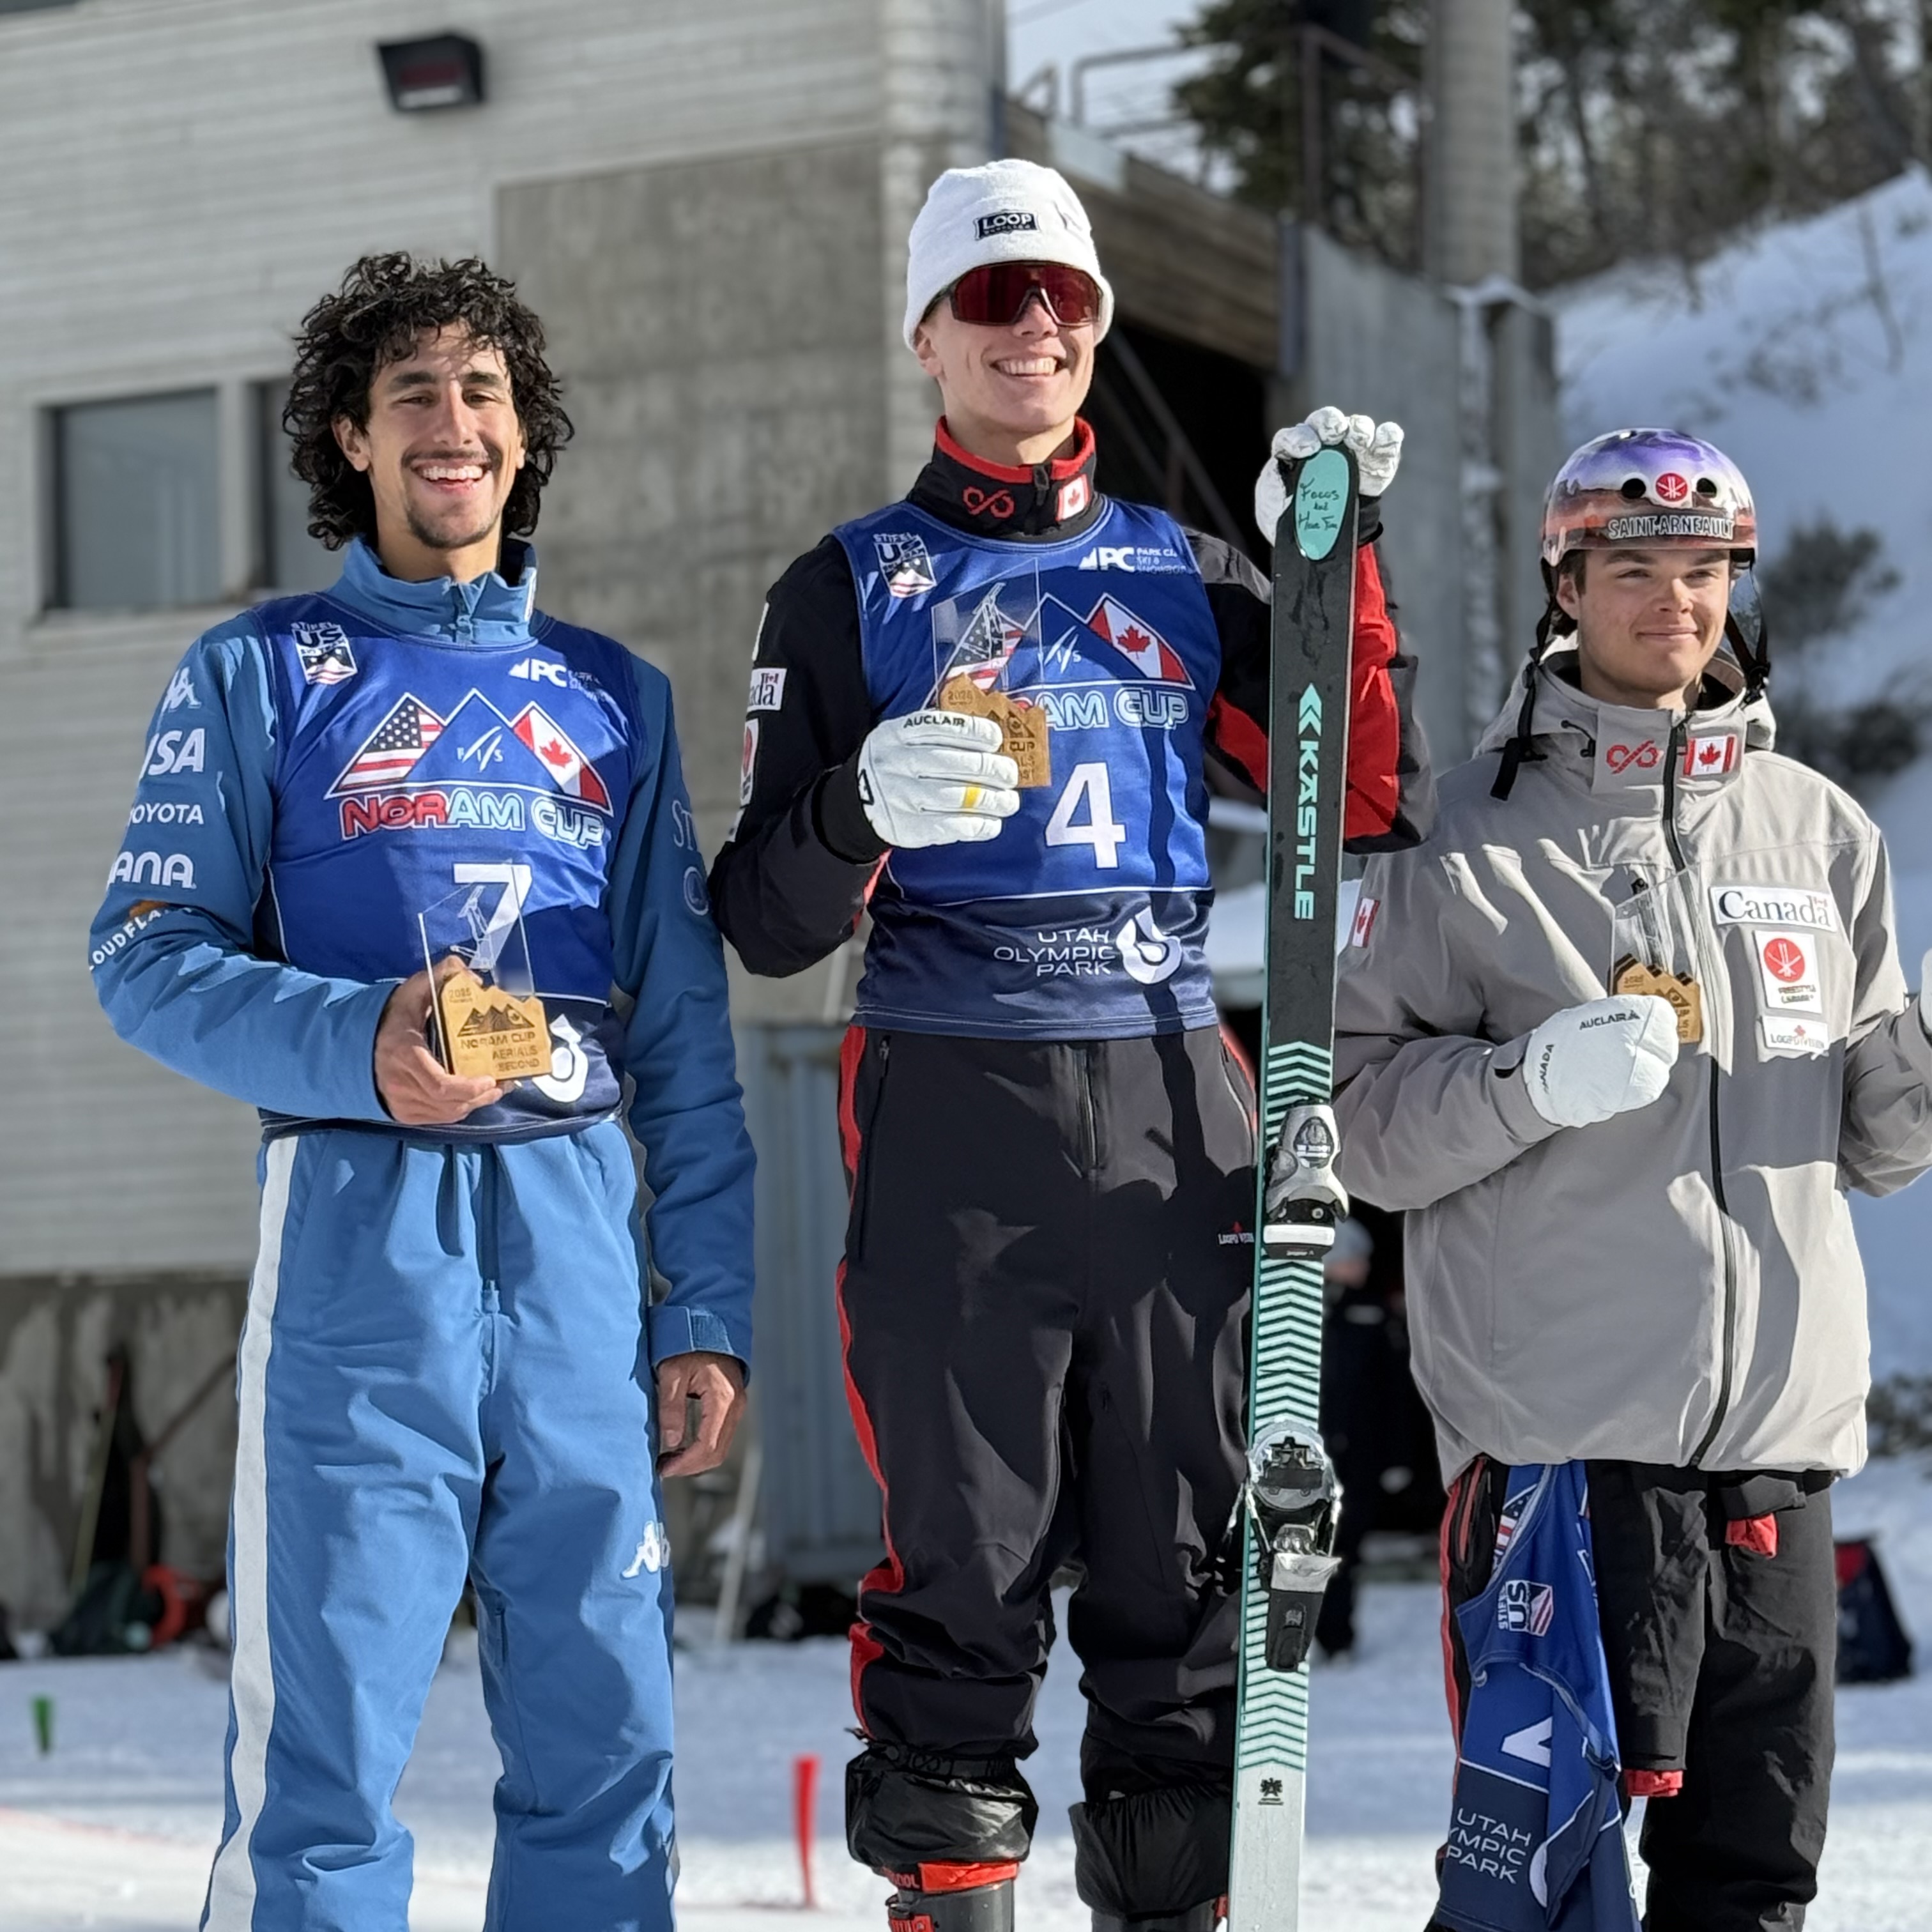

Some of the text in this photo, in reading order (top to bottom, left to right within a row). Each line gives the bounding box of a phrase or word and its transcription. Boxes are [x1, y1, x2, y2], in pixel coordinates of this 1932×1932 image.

[983, 213, 1032, 229] LOOP
[295, 627, 343, 648] US
[1113, 687, 1189, 730] CUP
[903, 715, 966, 729] AUCLAIR
[127, 803, 204, 827] OYOTA
[341, 788, 605, 850] NORAM CUP
[1045, 762, 1126, 868] 4
[106, 852, 194, 890] ANA
[453, 863, 532, 970] 7
[1719, 890, 1832, 927] Canada
[1038, 928, 1109, 944] UTAH
[993, 946, 1116, 962] OLYMPIC
[1036, 960, 1112, 977] PARK
[511, 1031, 535, 1043] CUP
[492, 1045, 539, 1061] AERIALS
[496, 1058, 540, 1072] SECOND
[1508, 1581, 1526, 1629] US
[1457, 1808, 1531, 1847] UTAH
[1445, 1844, 1517, 1885] PARK
